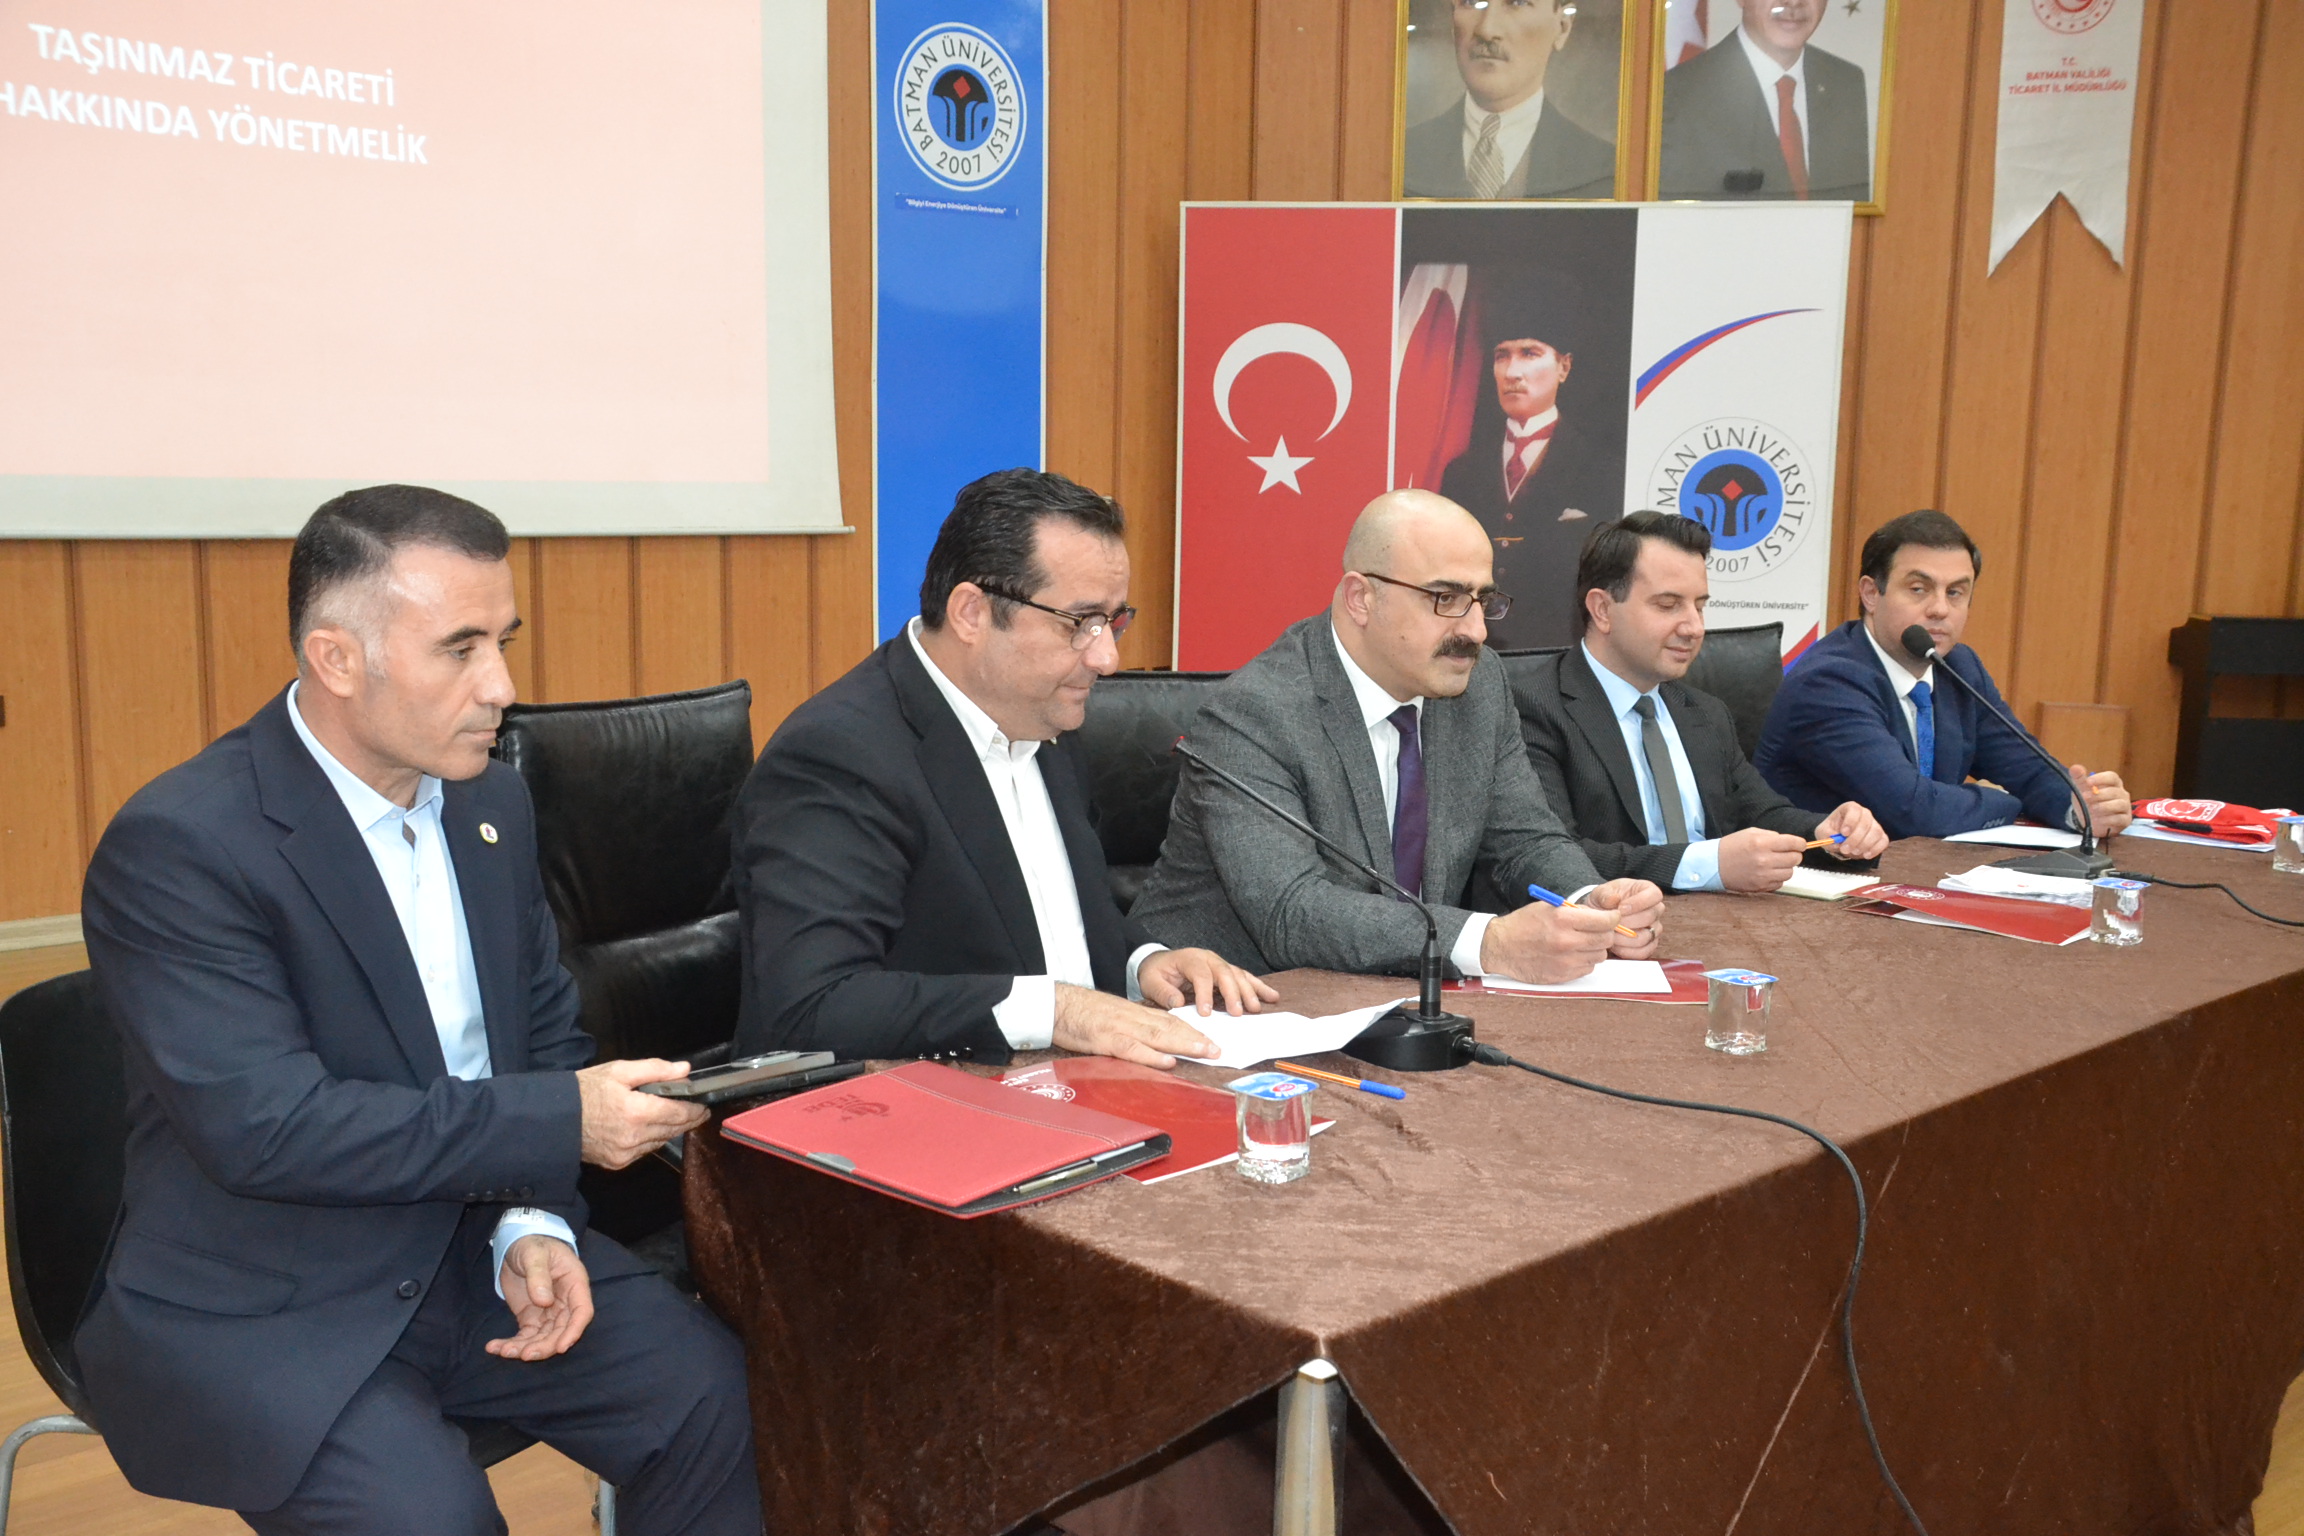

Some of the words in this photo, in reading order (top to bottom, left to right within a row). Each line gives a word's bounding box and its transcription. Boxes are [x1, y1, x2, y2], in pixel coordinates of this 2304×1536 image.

[27, 22, 236, 87] TAŞINMAZ
[242, 50, 395, 107] TİCARETİ
[2026, 70, 2068, 81] BATMAN
[0, 81, 200, 140] HAKKINDA
[207, 103, 429, 165] YÖNETMELİK
[905, 45, 939, 152] BATMAN
[942, 34, 1017, 164] ÜNİVERSİTESİ
[936, 151, 981, 176] 2007
[1656, 444, 1698, 508] MAN
[1703, 425, 1811, 568] ÜNİVERSİTESİ
[1705, 555, 1750, 573] 2007
[1709, 600, 1760, 609] DÖNÜŞTÜREN
